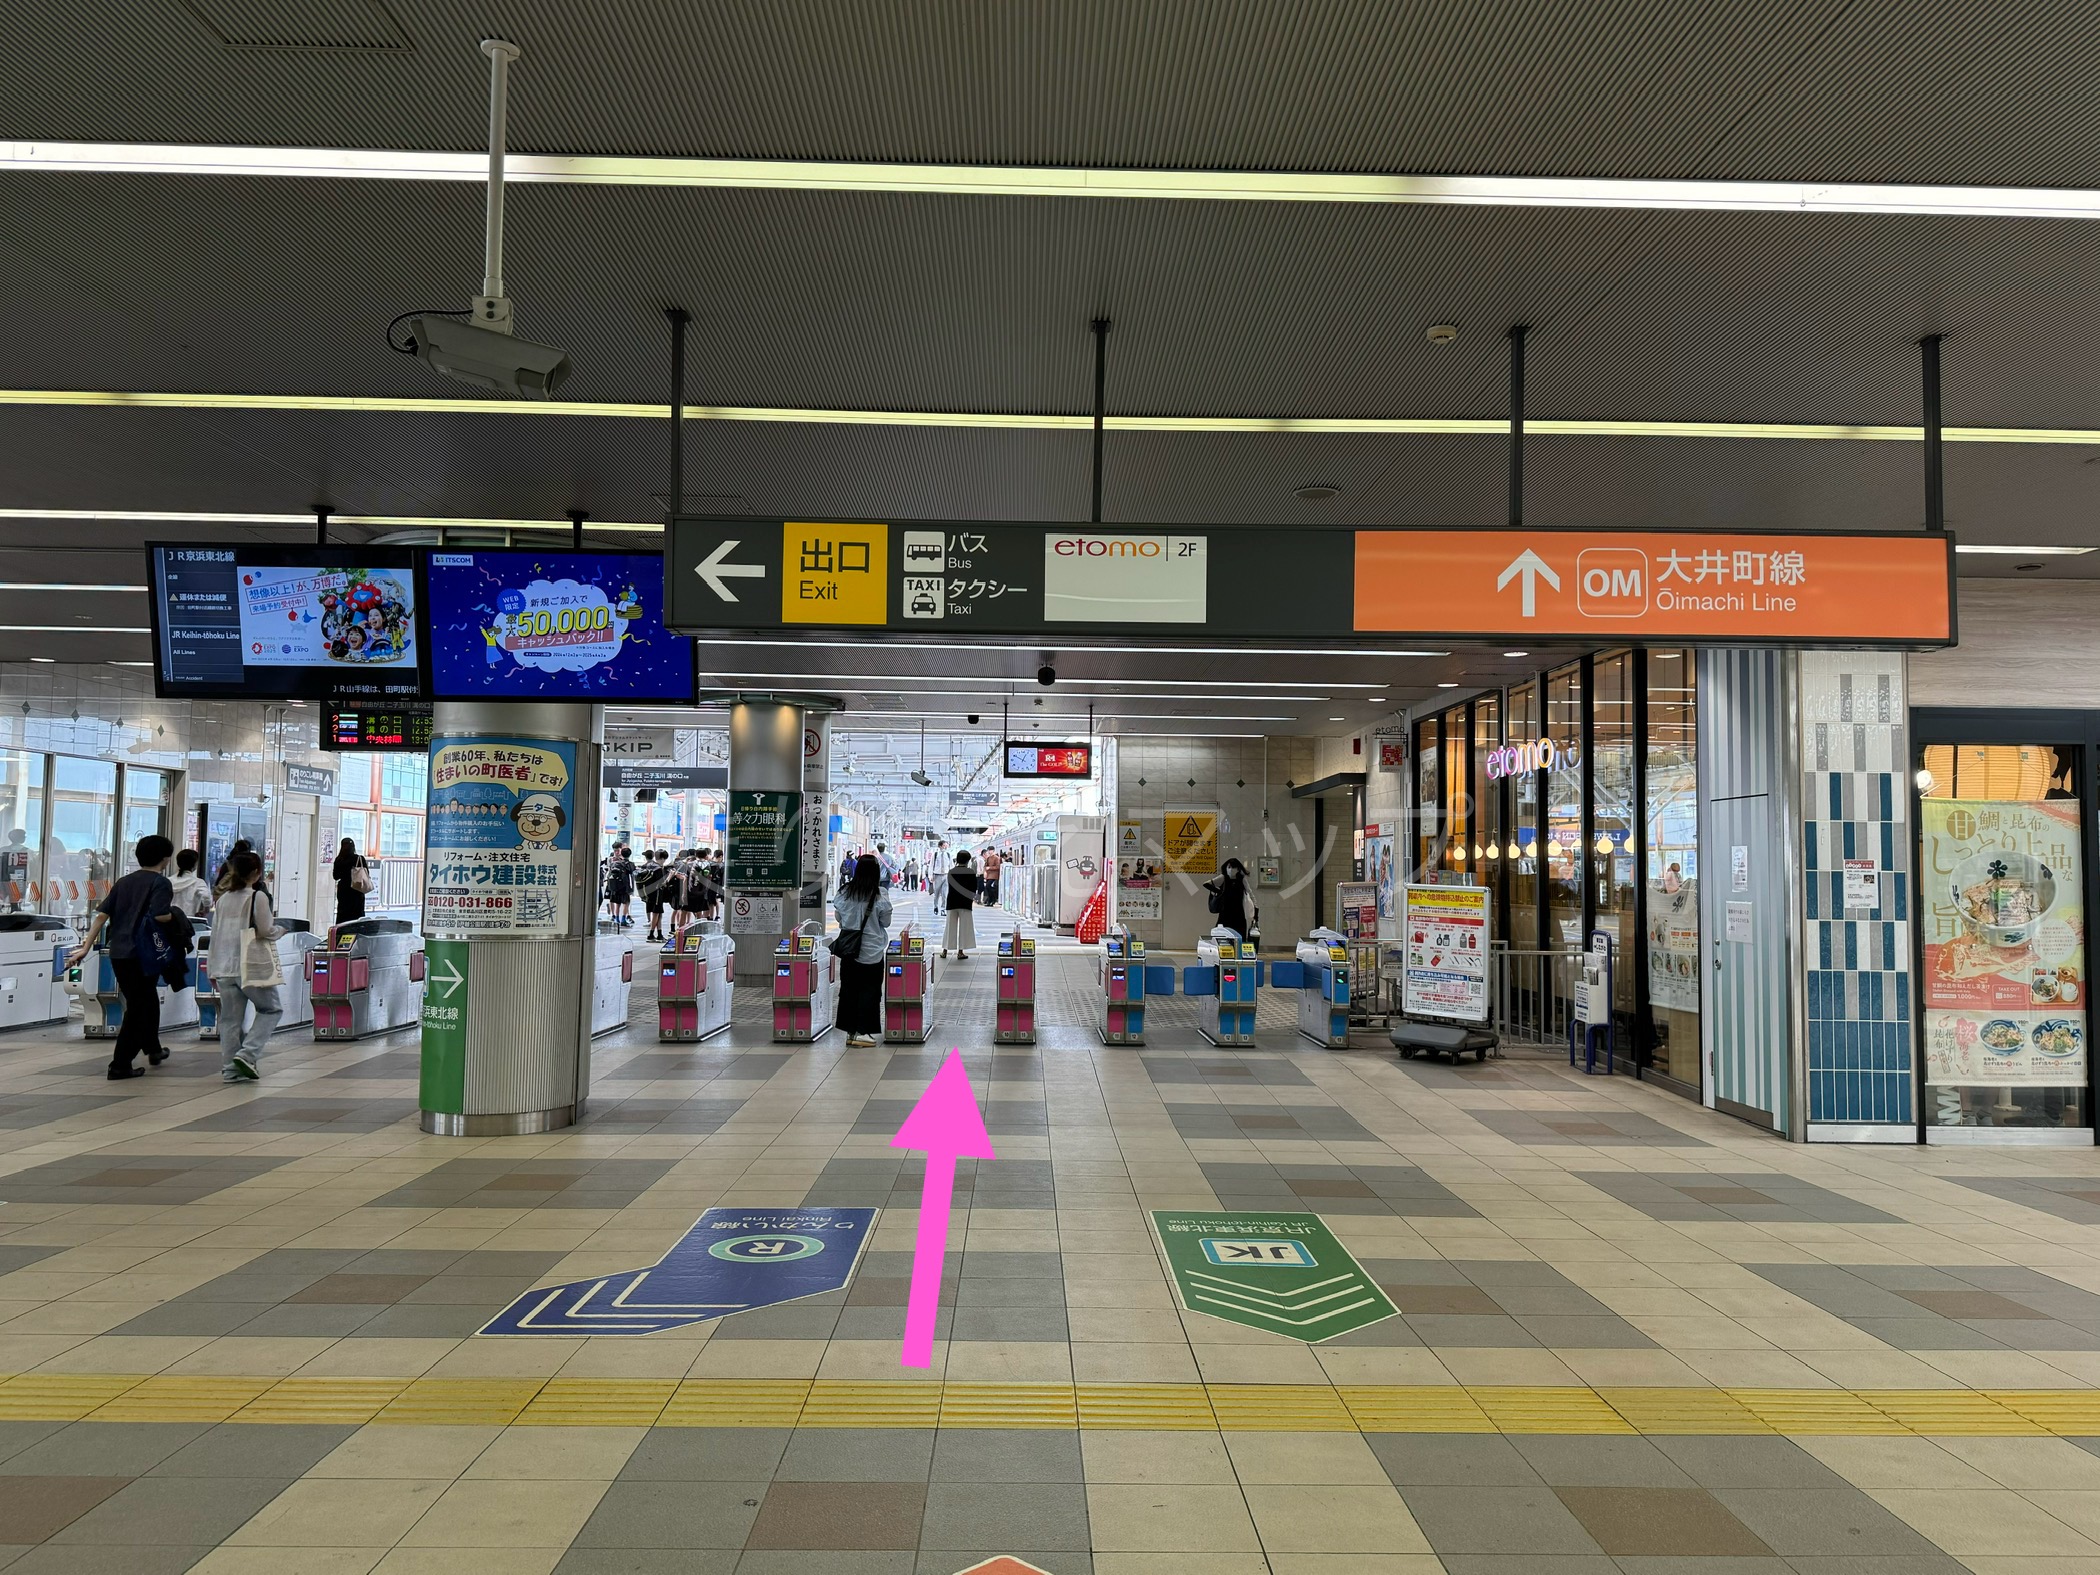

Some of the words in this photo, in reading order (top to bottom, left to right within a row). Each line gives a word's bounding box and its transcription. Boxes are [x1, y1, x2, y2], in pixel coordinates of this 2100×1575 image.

[948, 535, 988, 553] バス
[1054, 538, 1161, 558] etomo
[1178, 542, 1198, 558] 2F
[801, 537, 869, 573] 出口
[948, 556, 972, 570] Bus
[1656, 548, 1807, 586] 大井町線
[907, 579, 941, 592] TAXI
[947, 580, 1028, 598] タクシー
[1583, 568, 1642, 598] OM
[800, 580, 838, 601] Exit
[505, 603, 520, 611] 限定
[530, 596, 588, 608] 新規ご加入で
[1656, 588, 1745, 612] Ōimachi
[1753, 592, 1797, 612] Line
[947, 602, 972, 615] Taxi
[172, 631, 181, 639] JR
[226, 632, 240, 640] Line
[518, 630, 604, 648] キャッシュバック!!
[366, 716, 402, 725] 溝の口
[366, 726, 402, 734] 溝の口
[1376, 726, 1405, 735] etomo
[366, 735, 402, 744] 中央林間
[444, 750, 544, 766] 創業60年、私たちは
[1486, 738, 1556, 780] etomo
[434, 763, 563, 787] 「住まいの町医者」です!
[990, 793, 997, 803] 2
[733, 812, 787, 825] 等々力眼科
[1947, 810, 2050, 839] 甘鯛と昆布の
[812, 795, 822, 870] おつかれさまです
[444, 852, 531, 862] リフォーム・注文住宅
[1932, 831, 2073, 881] しっとり上品な
[430, 863, 536, 886] タイホウ建設
[538, 864, 557, 886] 株式会社
[433, 896, 513, 909] 0120-031-866
[443, 1022, 456, 1030] Line
[1934, 1029, 1944, 1049] 昆布
[711, 1222, 855, 1230] りんかい線
[1168, 1224, 1317, 1235] JR京浜東北線
[748, 1242, 786, 1255] R
[1221, 1246, 1289, 1259] JK
